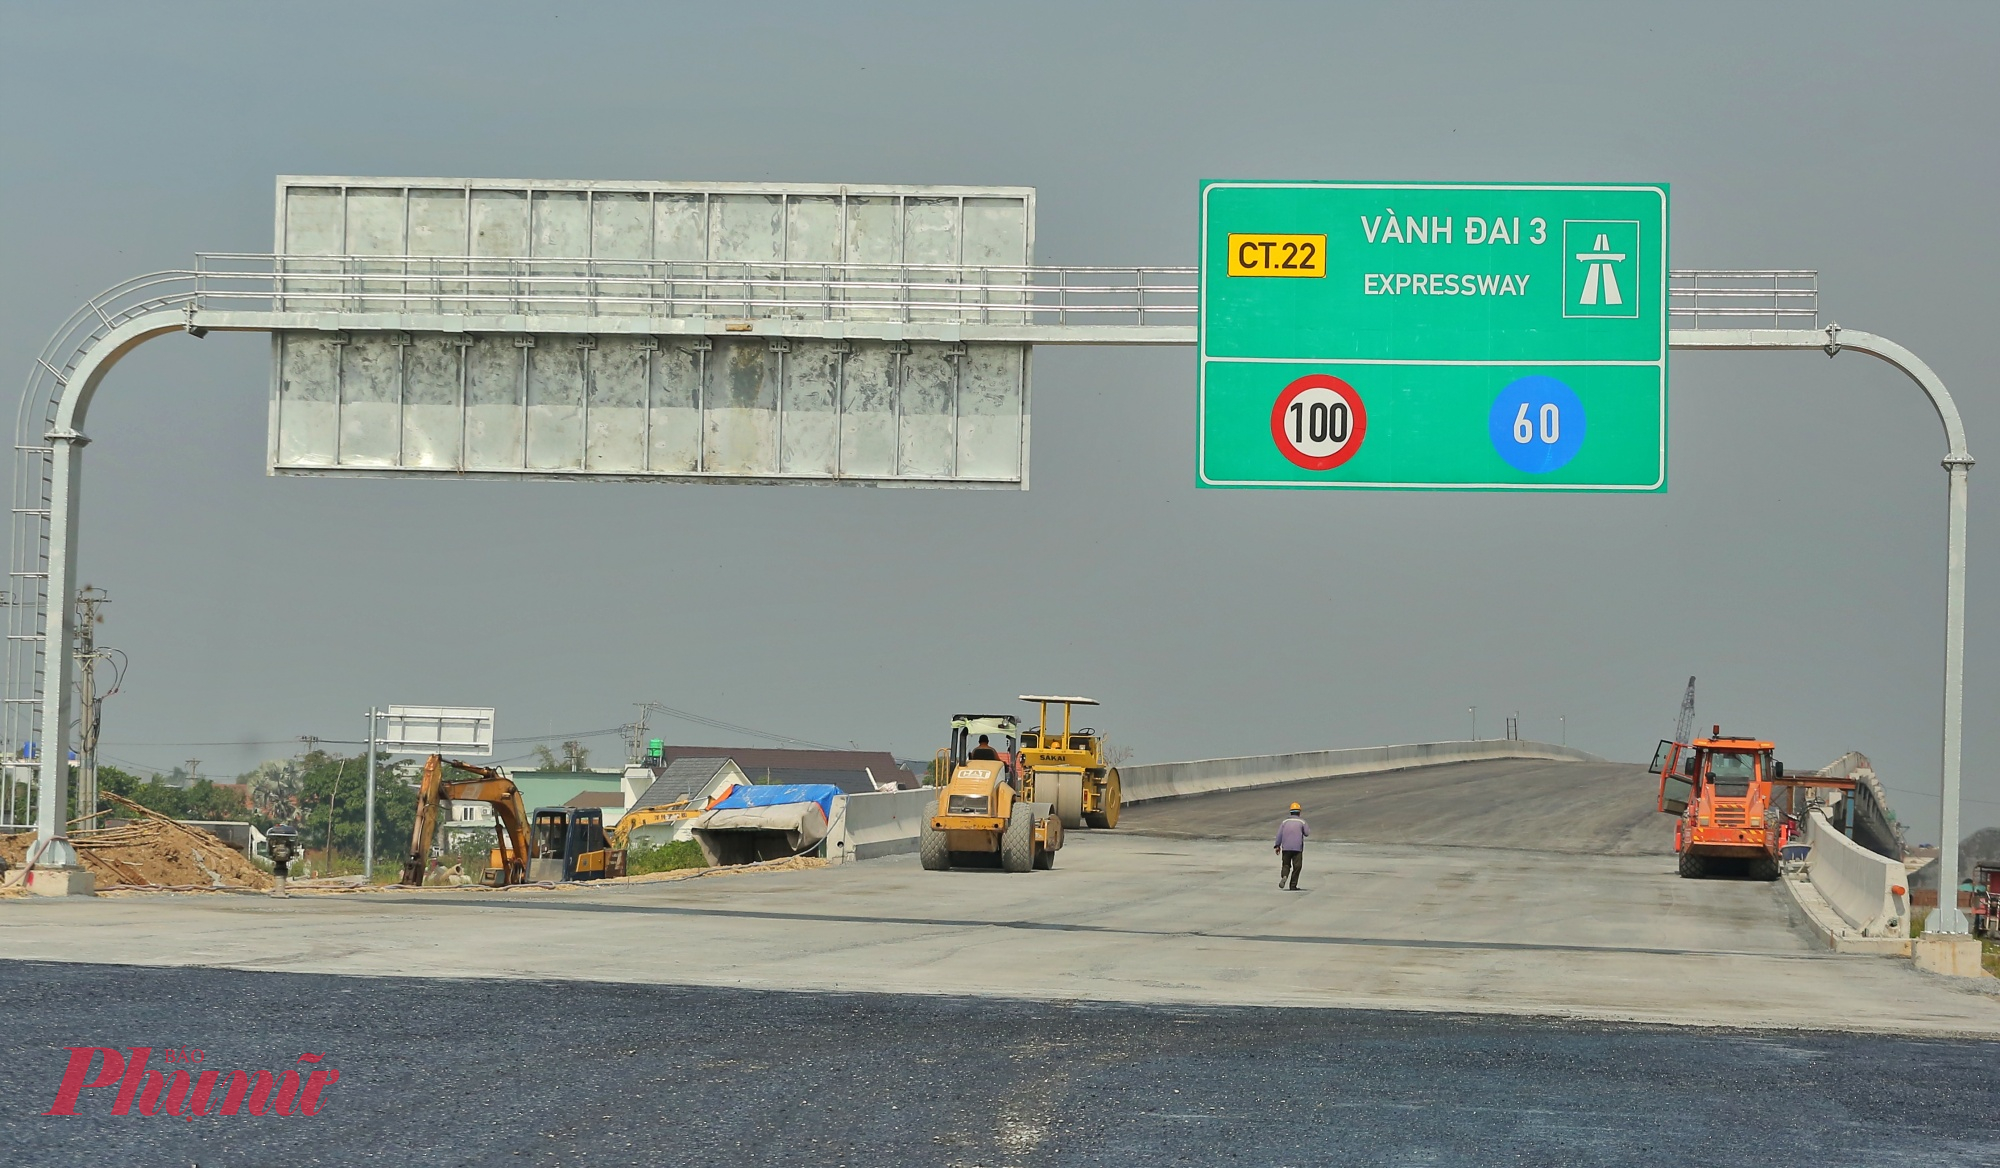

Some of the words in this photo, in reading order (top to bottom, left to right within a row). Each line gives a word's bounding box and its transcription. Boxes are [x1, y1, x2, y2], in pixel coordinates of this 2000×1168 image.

[1361, 207, 1453, 245] VÀNH
[1465, 216, 1520, 245] ĐAI
[1530, 217, 1547, 245] 3
[1238, 241, 1317, 270] CT.22
[1363, 273, 1531, 296] EXPRESSWAY
[1289, 402, 1348, 443] 100
[1513, 403, 1561, 444] 60
[1040, 754, 1066, 762] SAKAI
[960, 770, 990, 779] CAT
